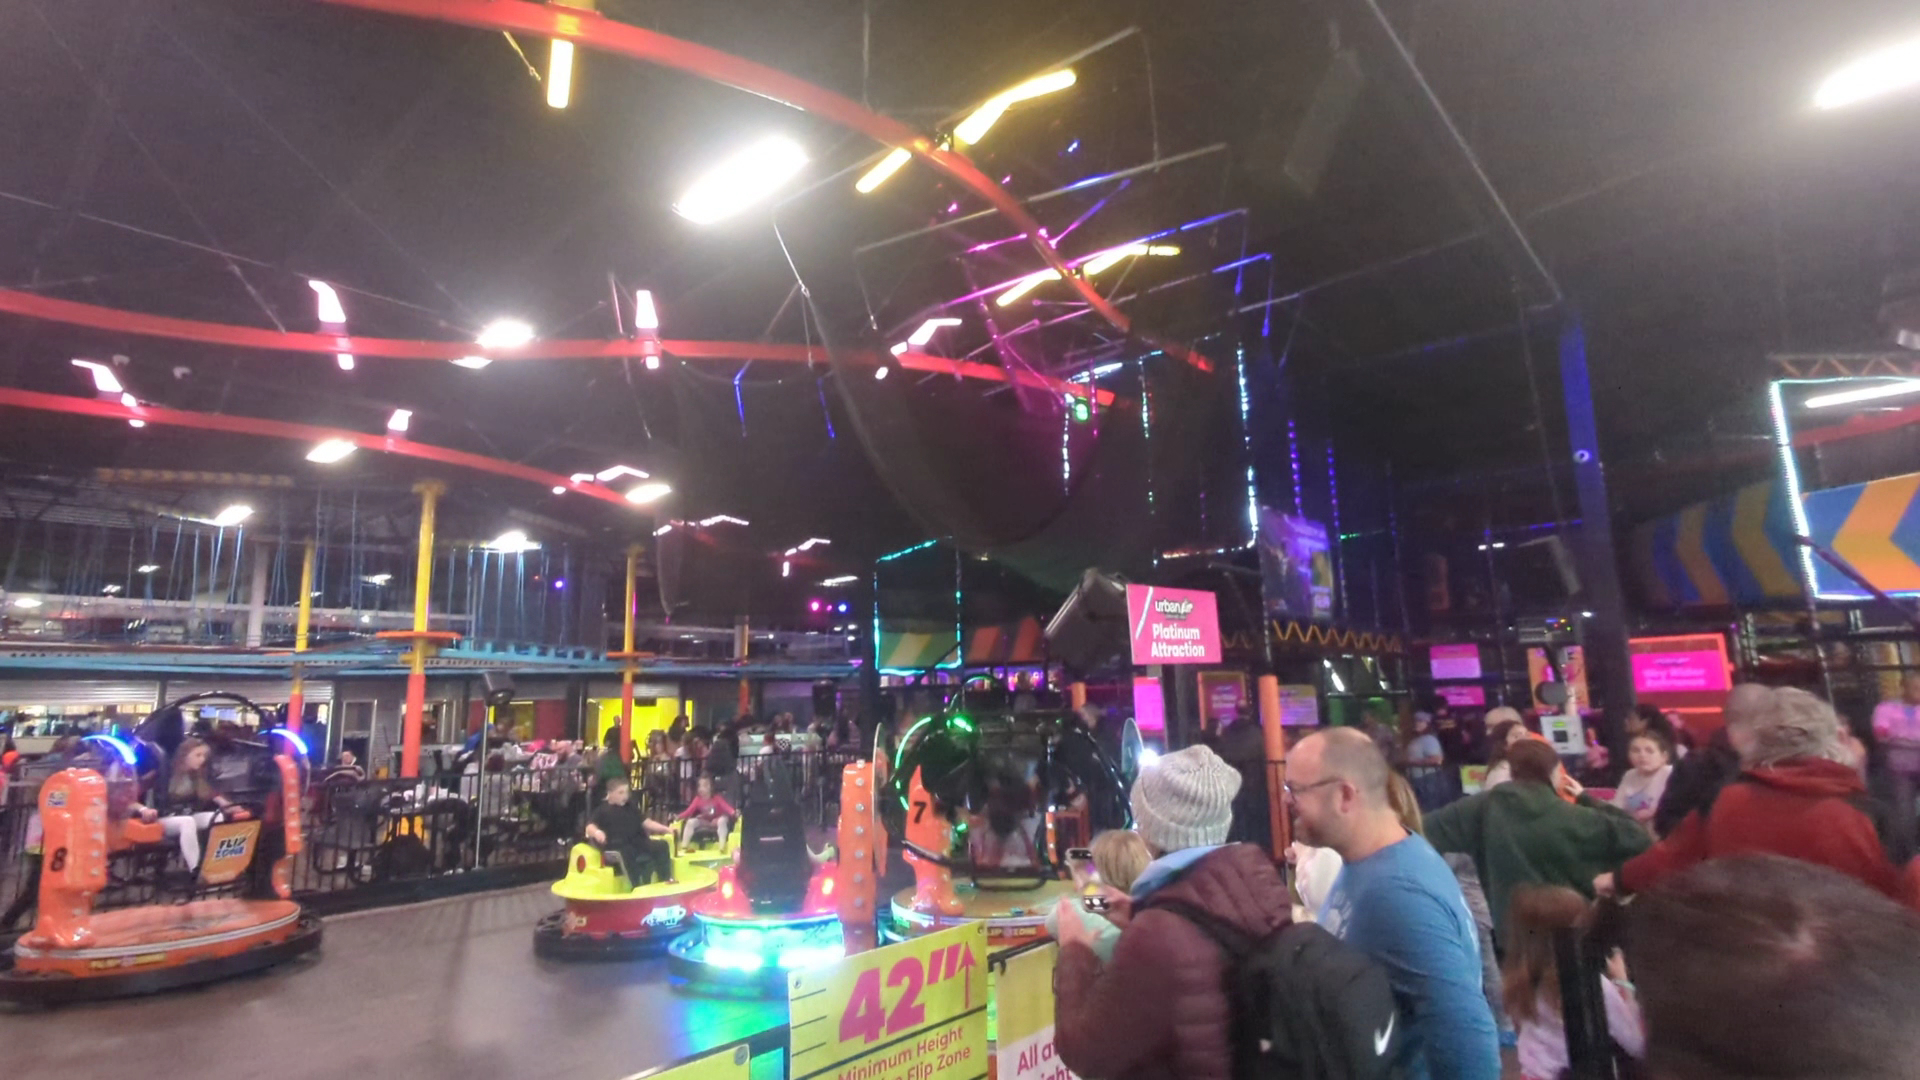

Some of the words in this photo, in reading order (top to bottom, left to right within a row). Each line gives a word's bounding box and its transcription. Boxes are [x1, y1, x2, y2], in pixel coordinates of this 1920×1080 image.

[1152, 623, 1200, 640] Platinum
[1151, 642, 1205, 657] Attraction
[914, 801, 927, 824] 7
[50, 847, 68, 872] 8
[838, 1049, 912, 1080] Minimum
[917, 1026, 963, 1057] Height
[907, 1062, 933, 1080] Flip
[937, 1047, 970, 1071] Zone
[1017, 1043, 1038, 1076] All
